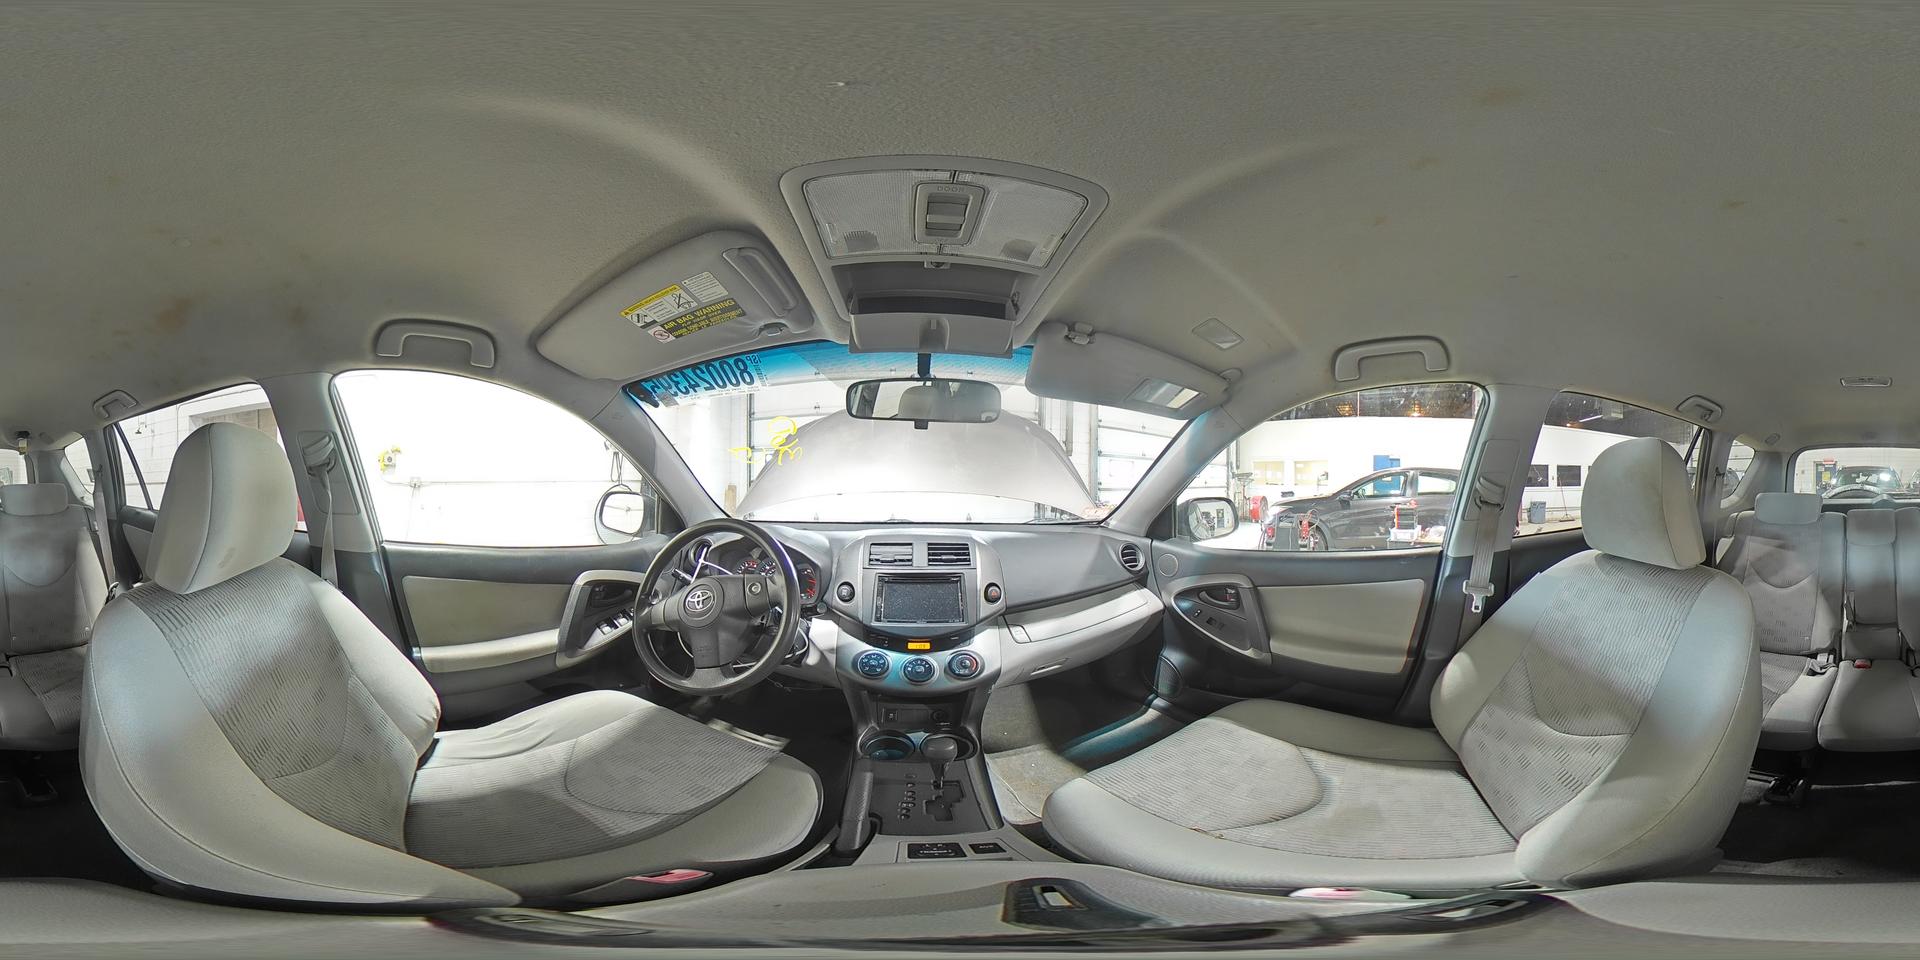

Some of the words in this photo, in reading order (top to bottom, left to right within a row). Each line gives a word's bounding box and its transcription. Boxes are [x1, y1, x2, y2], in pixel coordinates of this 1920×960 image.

[664, 321, 677, 330] AIR
[677, 314, 694, 324] BAG
[694, 299, 735, 316] WARNING
